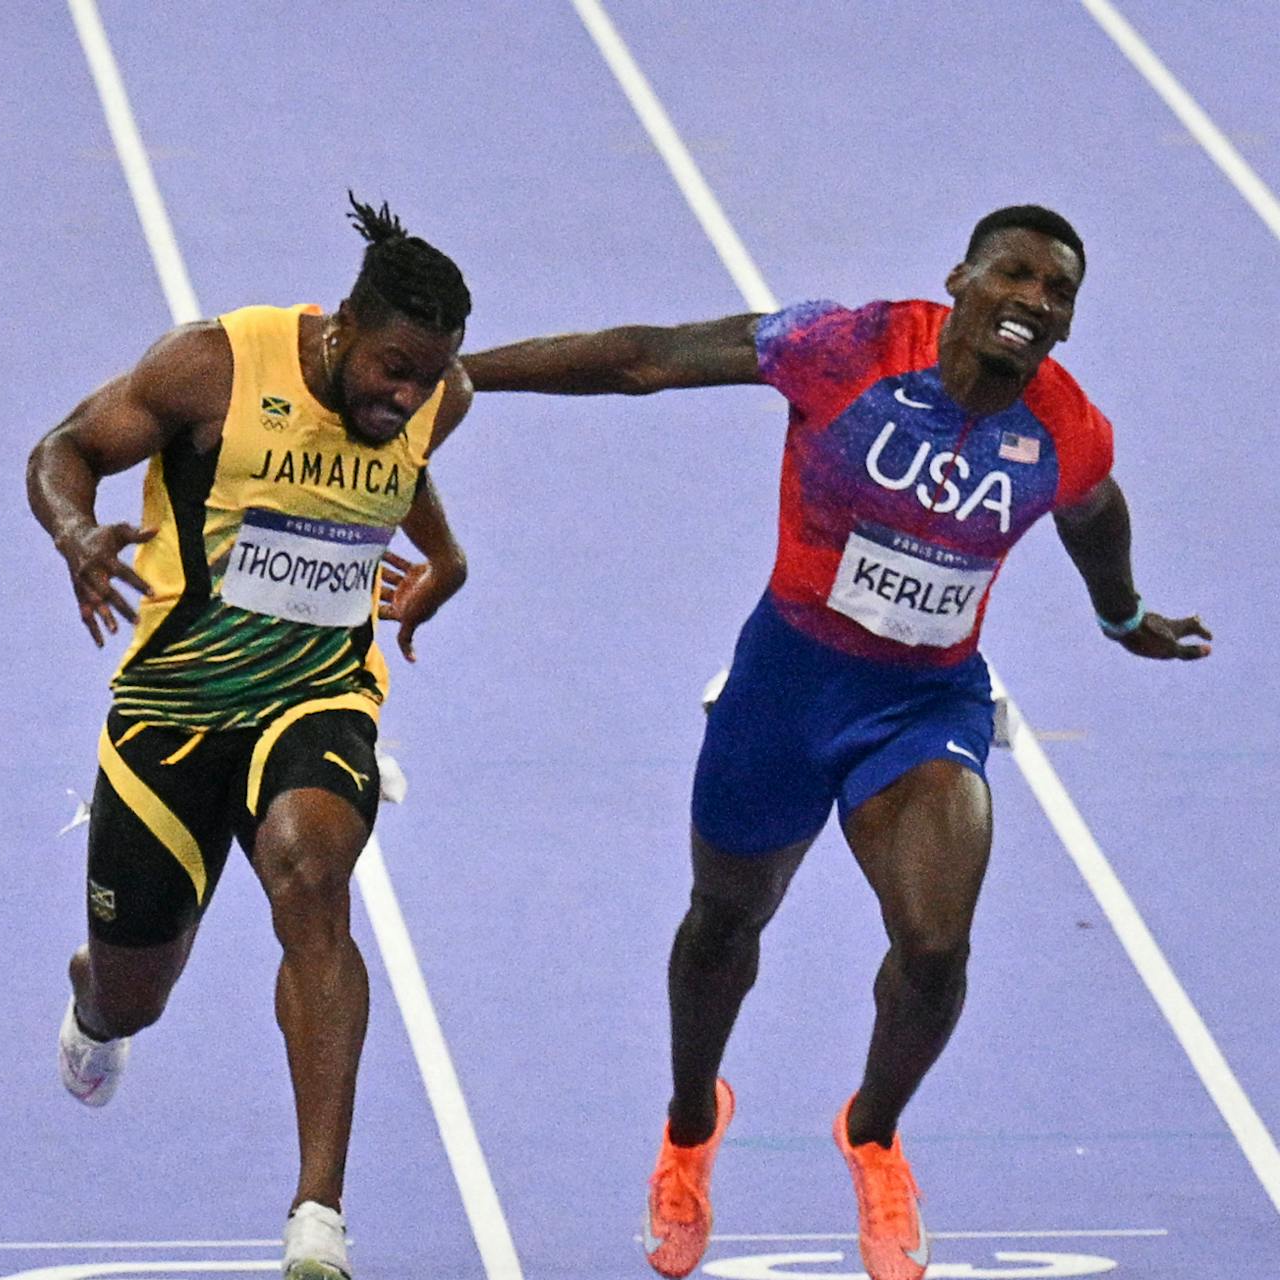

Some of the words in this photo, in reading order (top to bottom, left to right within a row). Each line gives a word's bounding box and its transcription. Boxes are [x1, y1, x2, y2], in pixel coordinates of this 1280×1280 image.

[251, 449, 400, 496] JAMAICA
[865, 421, 1012, 533] USA
[286, 519, 325, 535] PARIS
[328, 527, 362, 541] 2024
[893, 537, 933, 558] PARIS
[238, 541, 374, 593] THOMPSON
[853, 556, 976, 616] KERLEY
